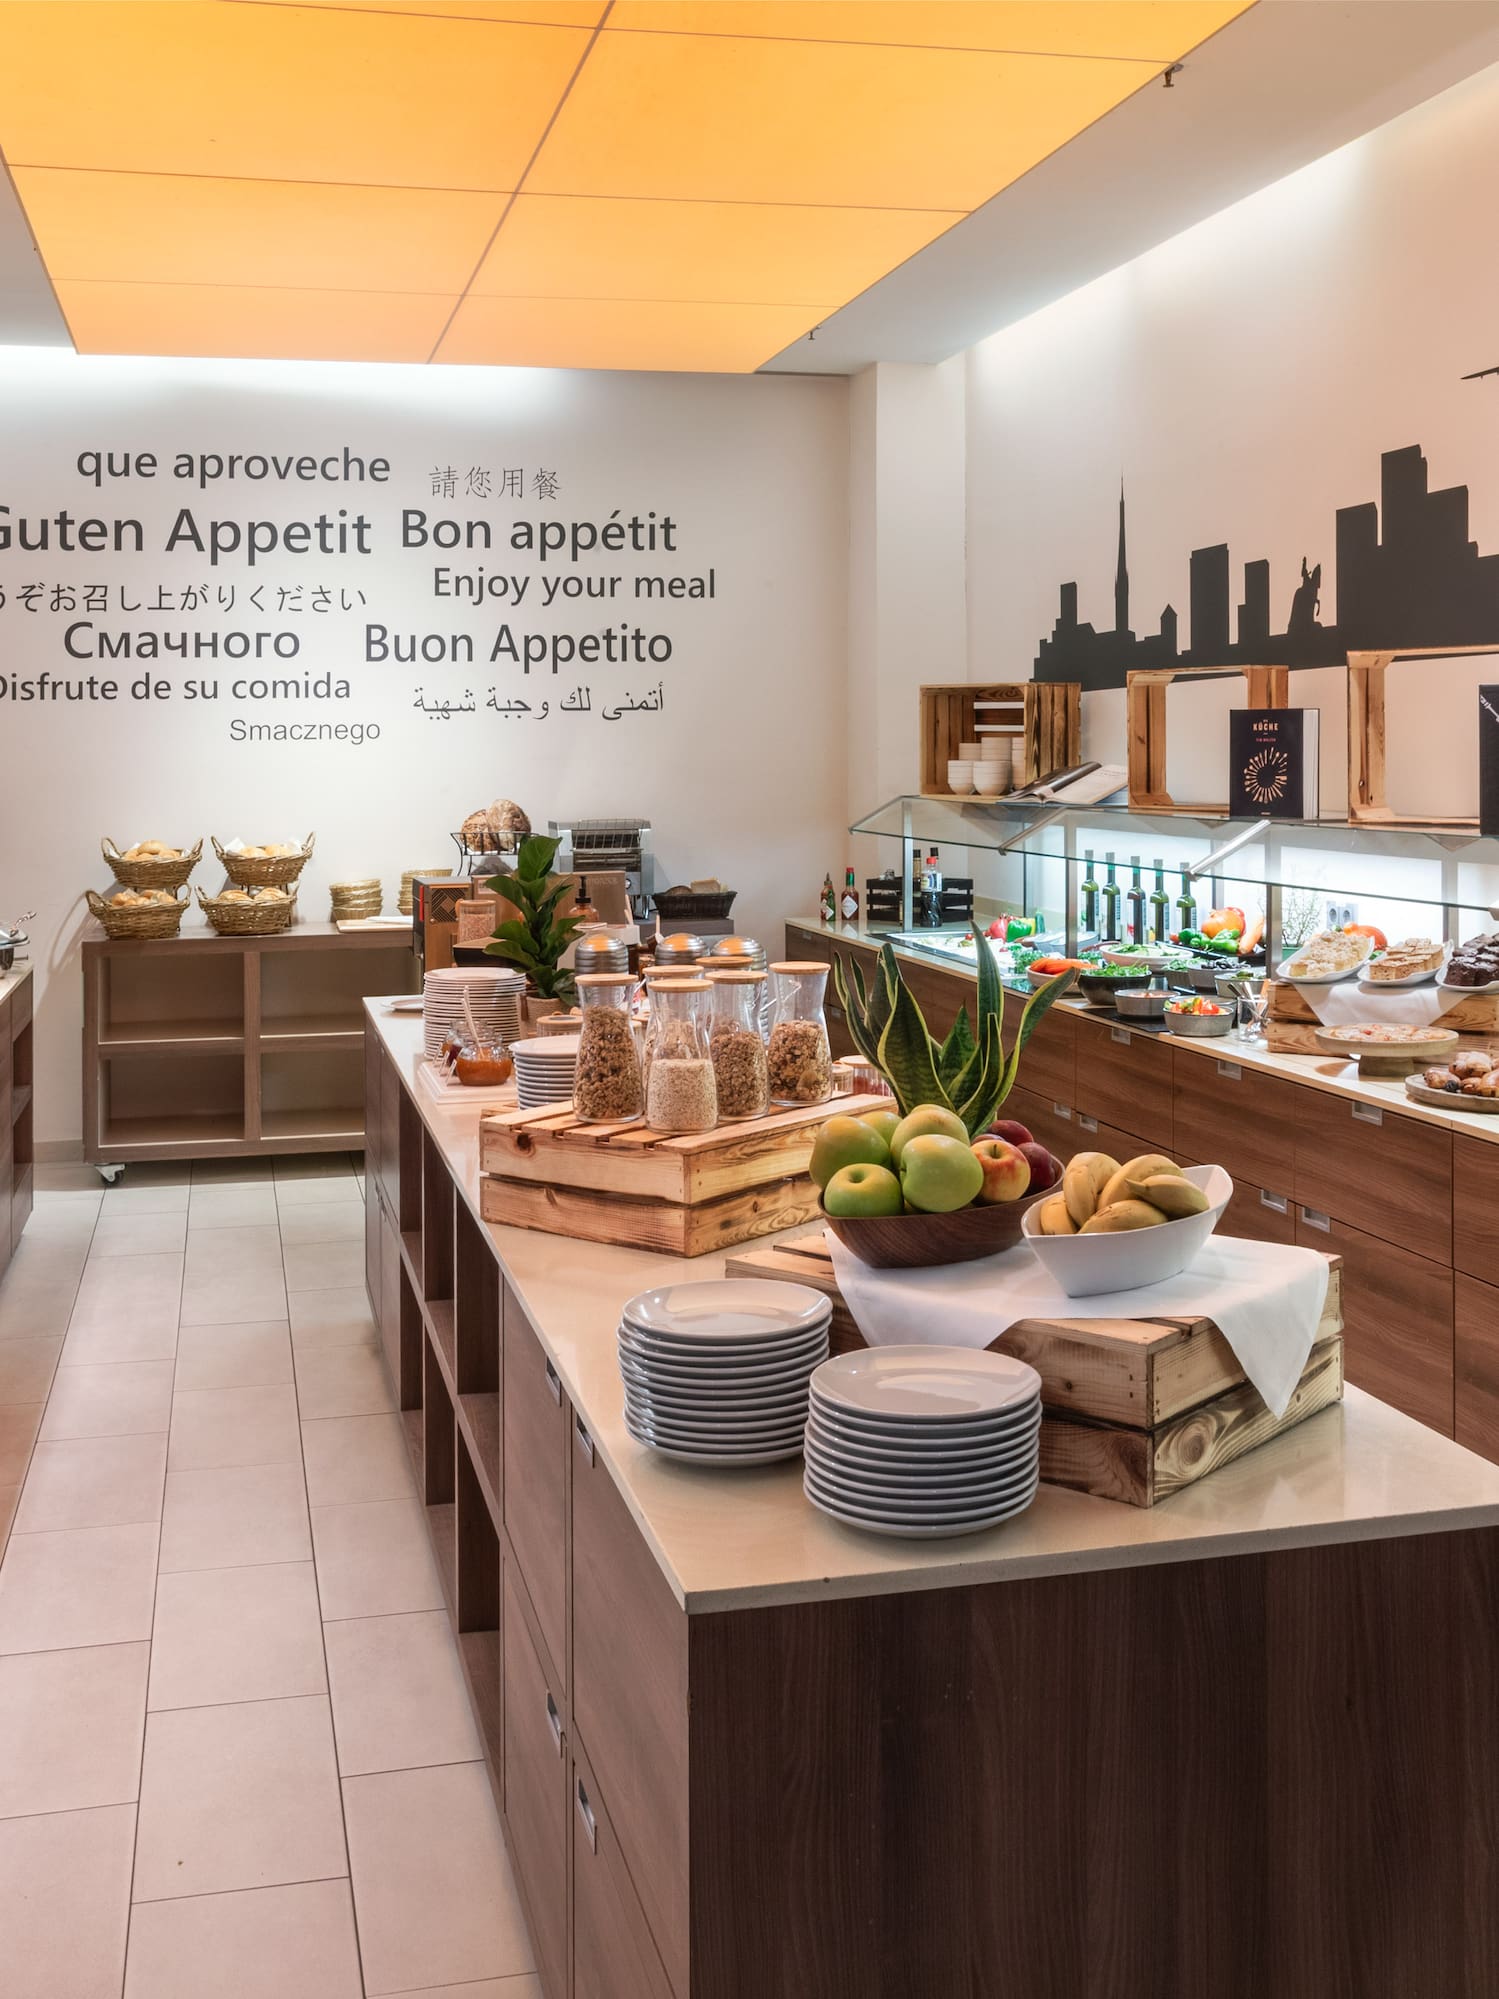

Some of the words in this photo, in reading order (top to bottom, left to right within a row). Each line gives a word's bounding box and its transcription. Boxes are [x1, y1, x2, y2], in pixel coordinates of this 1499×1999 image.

[77, 450, 157, 487] que
[173, 447, 390, 489] aproveche
[428, 464, 562, 501] 請您用餐
[165, 509, 371, 566] Appetit
[402, 509, 491, 549] Bon
[510, 510, 676, 562] appétit
[434, 566, 530, 606] Enjoy
[542, 576, 622, 606] your
[635, 568, 715, 599] meal
[64, 621, 300, 659] Смачного
[366, 624, 473, 662] Buon
[490, 623, 672, 674] Appetito
[131, 672, 171, 700] de
[184, 680, 218, 699] su
[232, 671, 350, 699] comida
[413, 687, 475, 720] شهية
[486, 687, 549, 720] وجبة
[560, 686, 591, 711] لك
[602, 681, 664, 721] أتمنى
[229, 719, 381, 746] Smacznego
